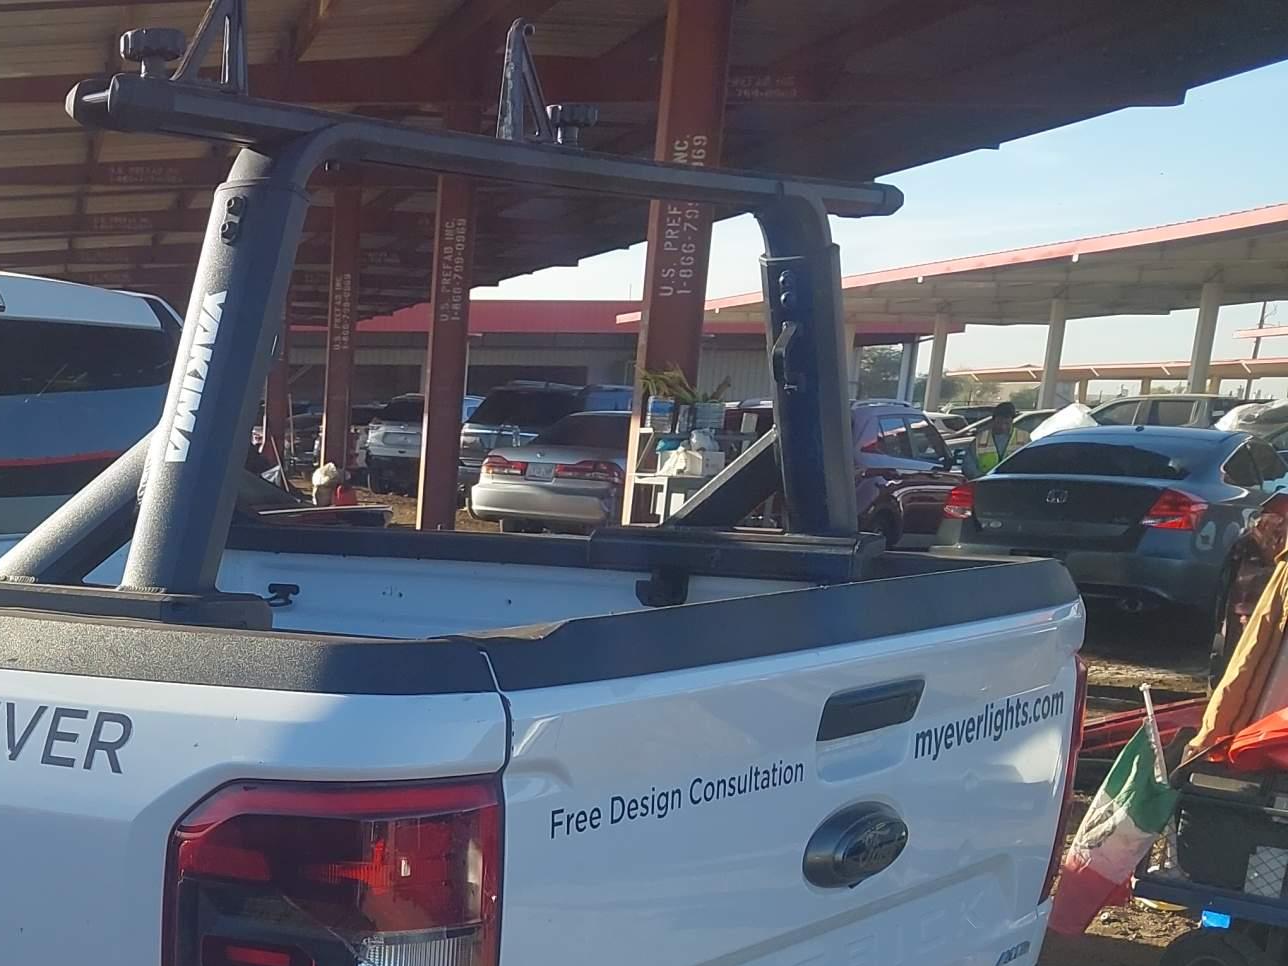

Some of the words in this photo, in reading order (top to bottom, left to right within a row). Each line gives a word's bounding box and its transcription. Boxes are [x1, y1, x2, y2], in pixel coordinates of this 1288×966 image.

[673, 134, 690, 164] NC.
[165, 290, 227, 462] YAKIMA
[914, 689, 1064, 760] myeverlights.com
[550, 803, 602, 840] Free
[610, 786, 682, 826] Design
[689, 759, 805, 803] Consultation
